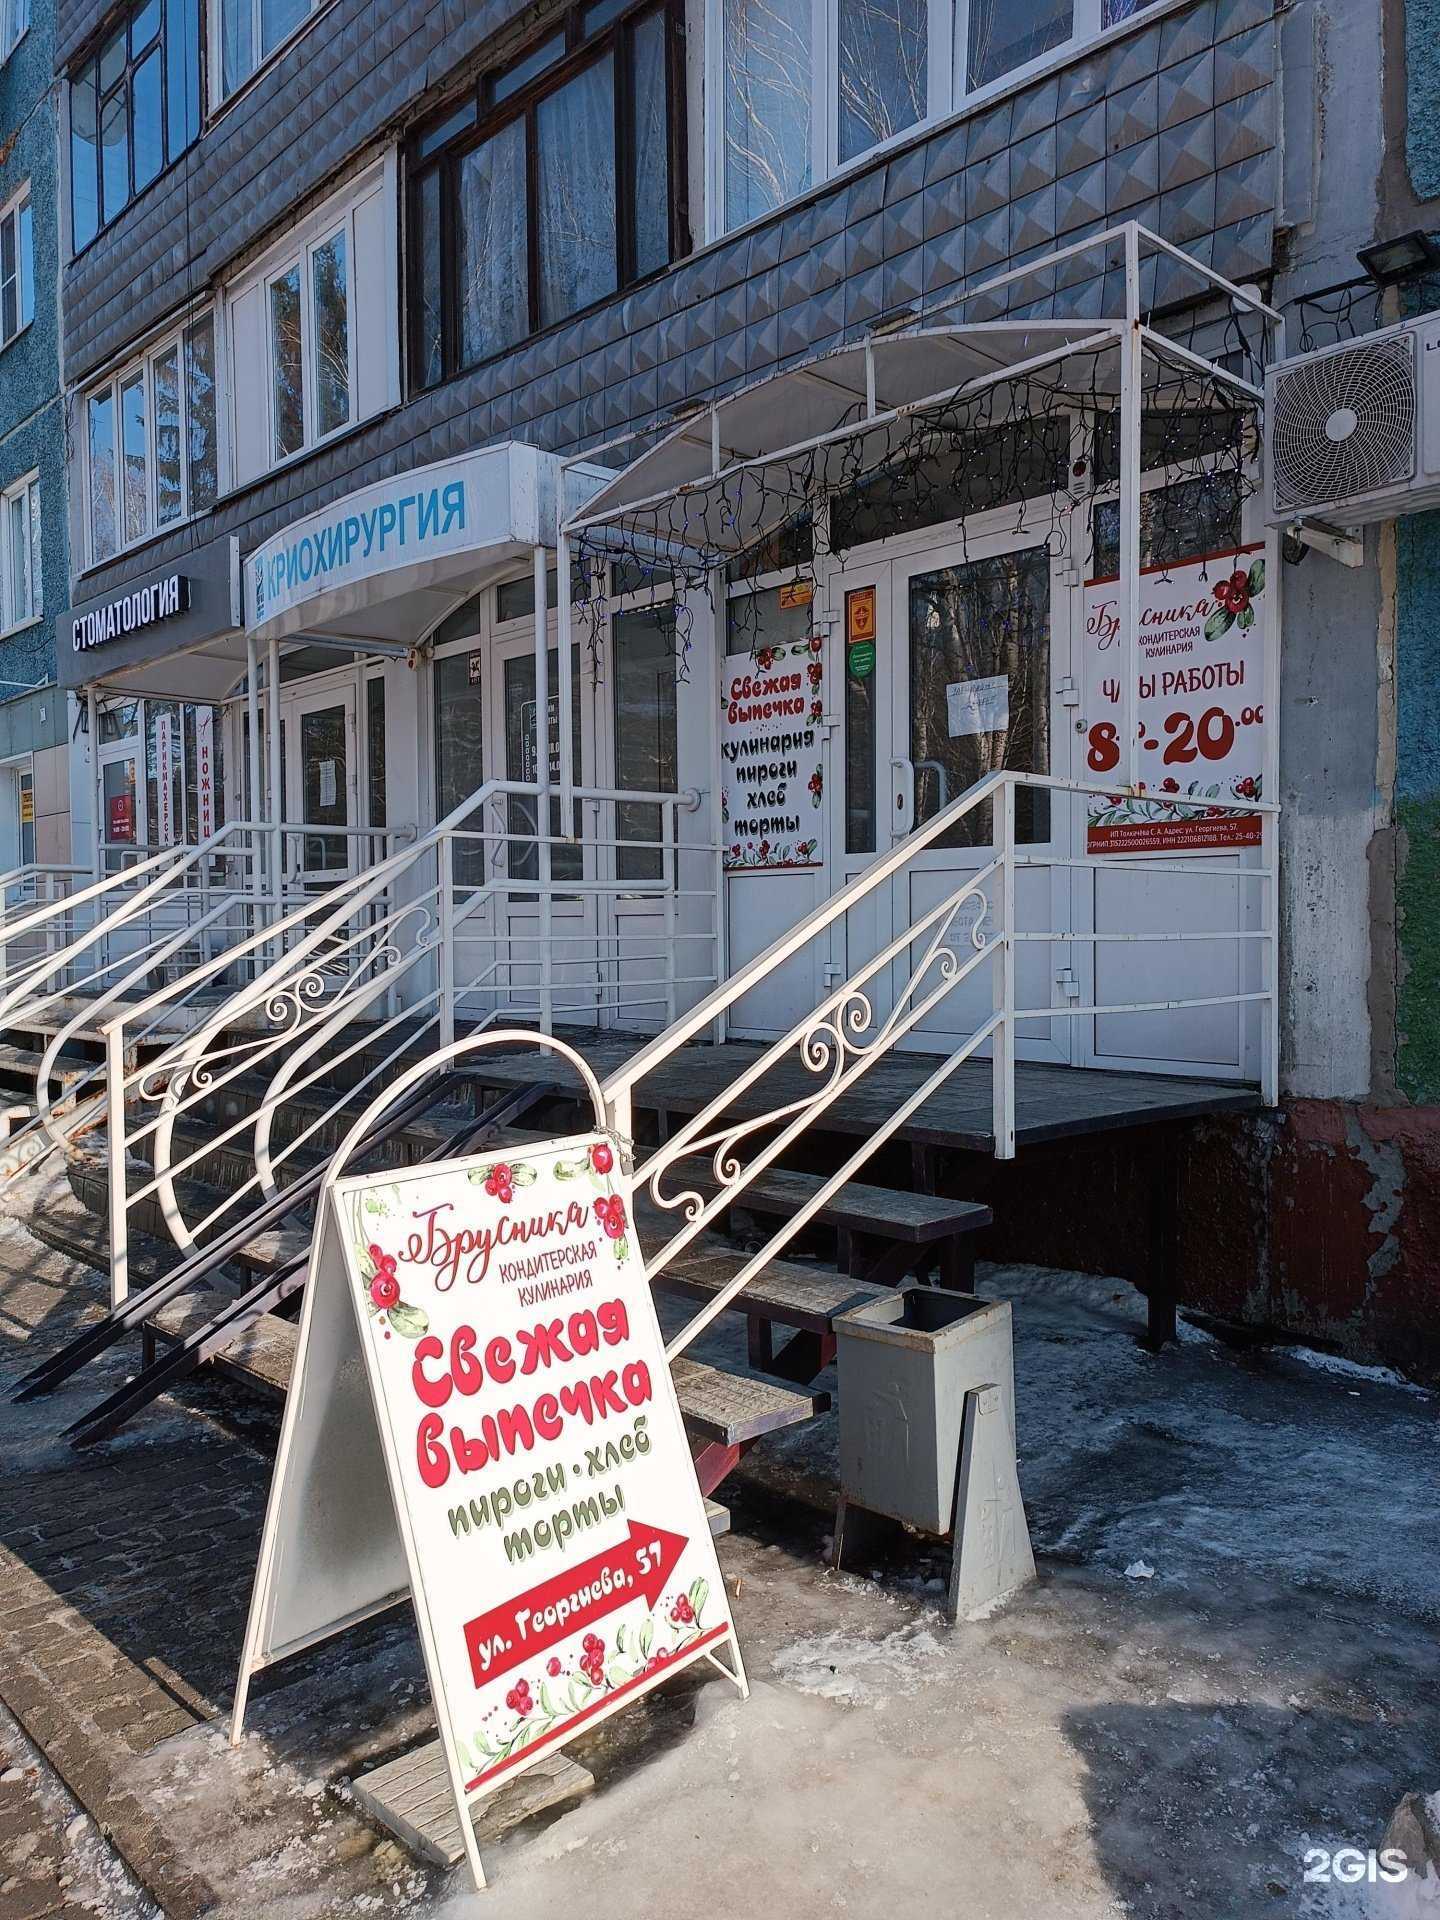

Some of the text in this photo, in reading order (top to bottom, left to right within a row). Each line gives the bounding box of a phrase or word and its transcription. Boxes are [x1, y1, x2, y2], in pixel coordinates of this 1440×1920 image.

[267, 480, 465, 601] КРИОХИРУРГИЯ
[72, 574, 179, 652] СТОМАТОЛОГИЯ
[1086, 598, 1216, 651] Брсника
[1145, 641, 1194, 659] КУЛИНАРИЯ
[730, 672, 802, 701] Свежая
[1103, 660, 1244, 703] ЧЫ РАБОТЫ
[727, 697, 805, 725] выпечка
[721, 729, 815, 763] кулинария
[160, 720, 170, 846] ПАРИКМАХЕРСК
[200, 745, 212, 839] НОЖНИЦ
[736, 760, 797, 786] пироги
[747, 782, 787, 808] хлеб
[734, 815, 801, 839] торты
[1110, 831, 1119, 839] ИП
[398, 1201, 589, 1292] Брусника
[499, 1240, 598, 1284] КОНДИТЕРСКАЯ
[517, 1269, 594, 1308] КУЛИНАРИЯ
[411, 1298, 630, 1408] Свежая
[416, 1359, 653, 1489] выпечка
[447, 1415, 651, 1538] пироги хлеб
[503, 1484, 626, 1563] торты
[478, 1539, 663, 1671] ул. Георгиева, 57
